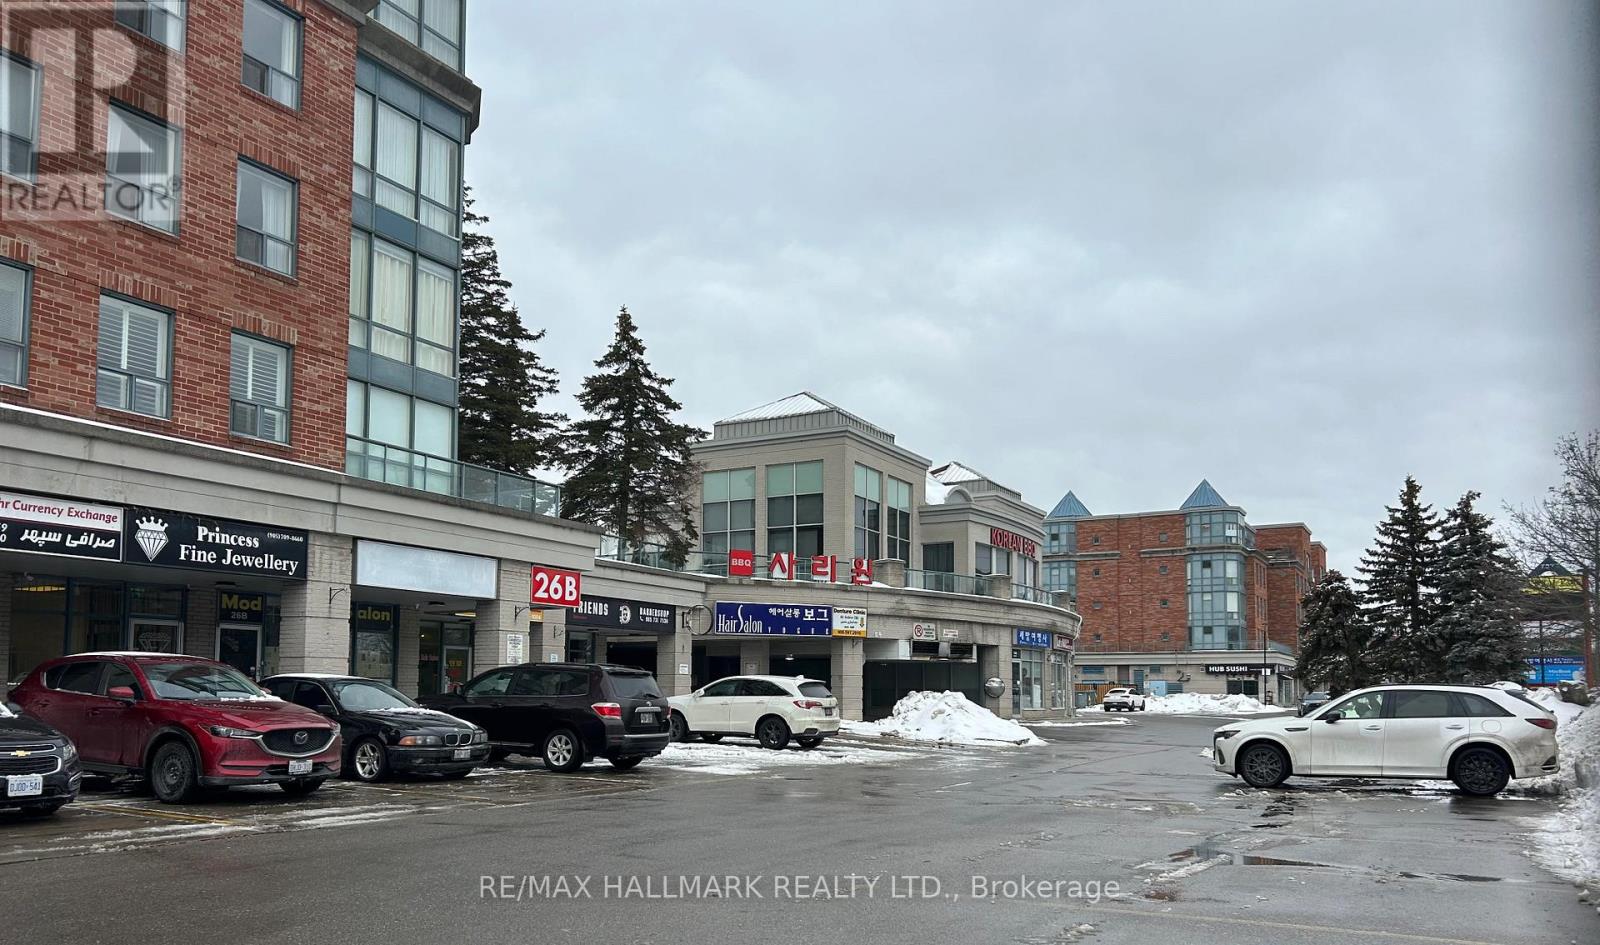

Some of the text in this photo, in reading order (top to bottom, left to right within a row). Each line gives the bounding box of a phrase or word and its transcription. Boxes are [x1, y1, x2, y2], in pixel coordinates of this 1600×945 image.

[12, 500, 64, 517] Currency
[67, 506, 118, 524] Exchange
[196, 525, 260, 548] Princess
[991, 528, 1023, 553] KOREAN
[179, 543, 299, 576] Fine Jewellery
[731, 558, 752, 567] BBQ
[534, 571, 577, 601] 26B
[221, 593, 262, 611] Mod
[718, 604, 763, 633] Hair Salon
[803, 608, 829, 621] 보그
